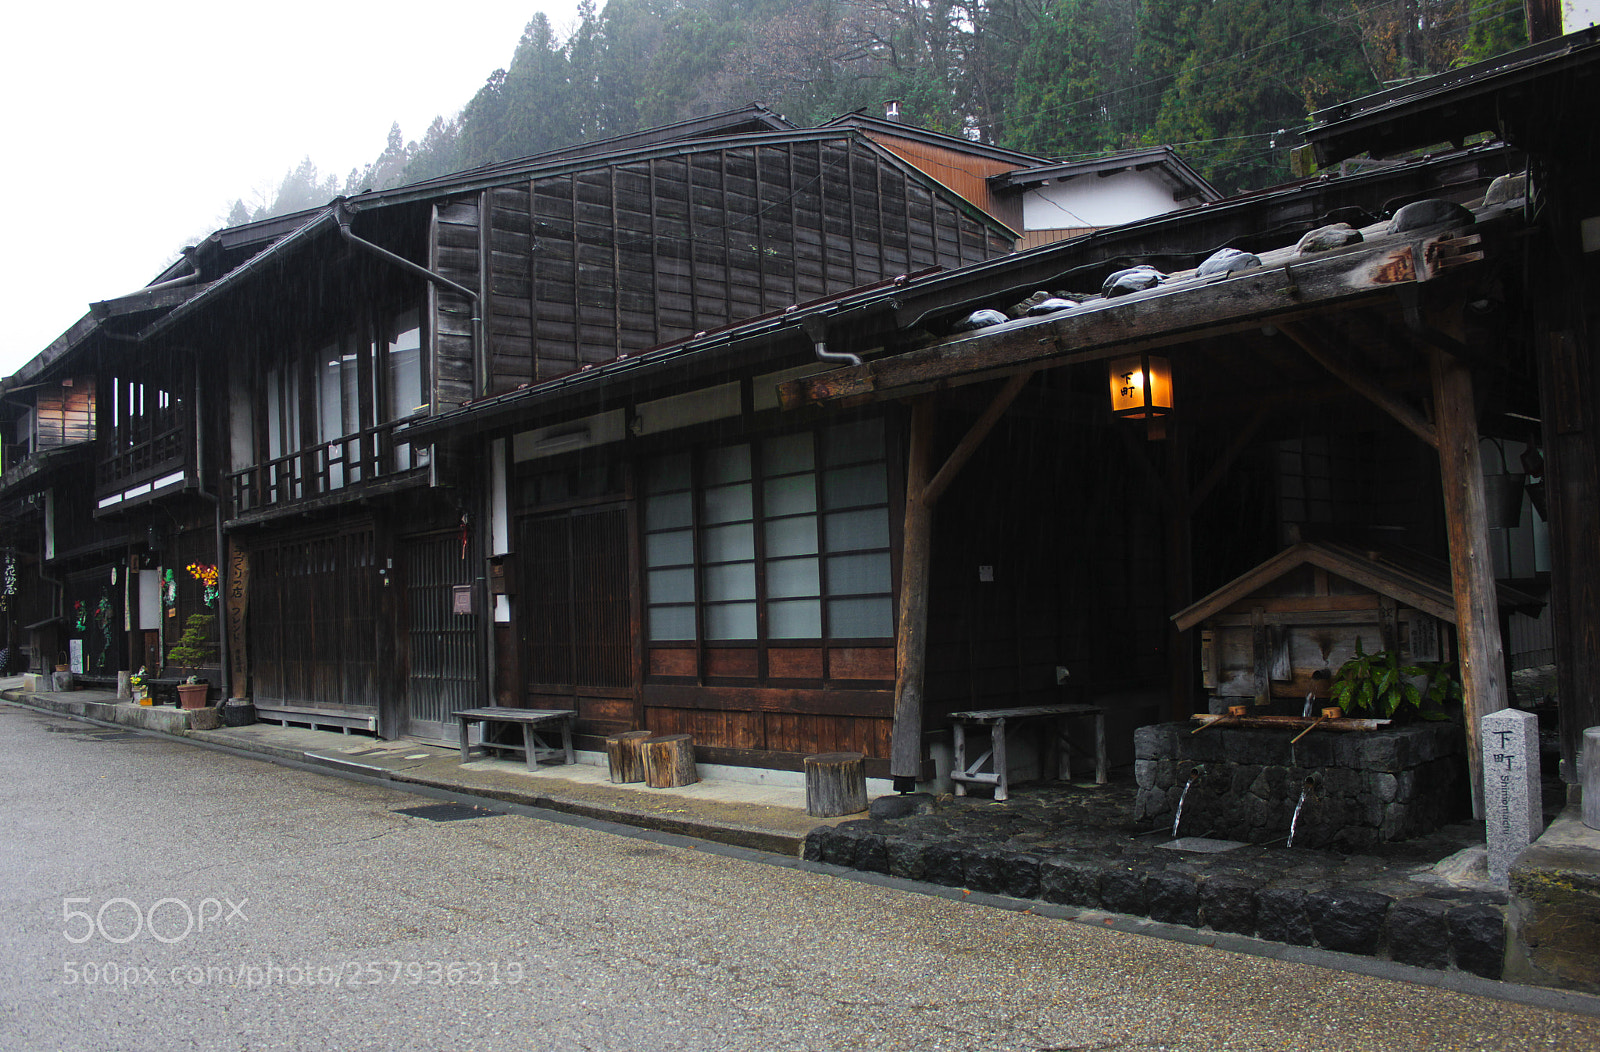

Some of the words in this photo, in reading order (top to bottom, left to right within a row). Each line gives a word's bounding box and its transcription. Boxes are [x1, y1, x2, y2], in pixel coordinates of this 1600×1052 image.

[1120, 371, 1135, 398] 下町
[1492, 730, 1515, 771] 下町
[1500, 775, 1511, 835] Shimomachi
